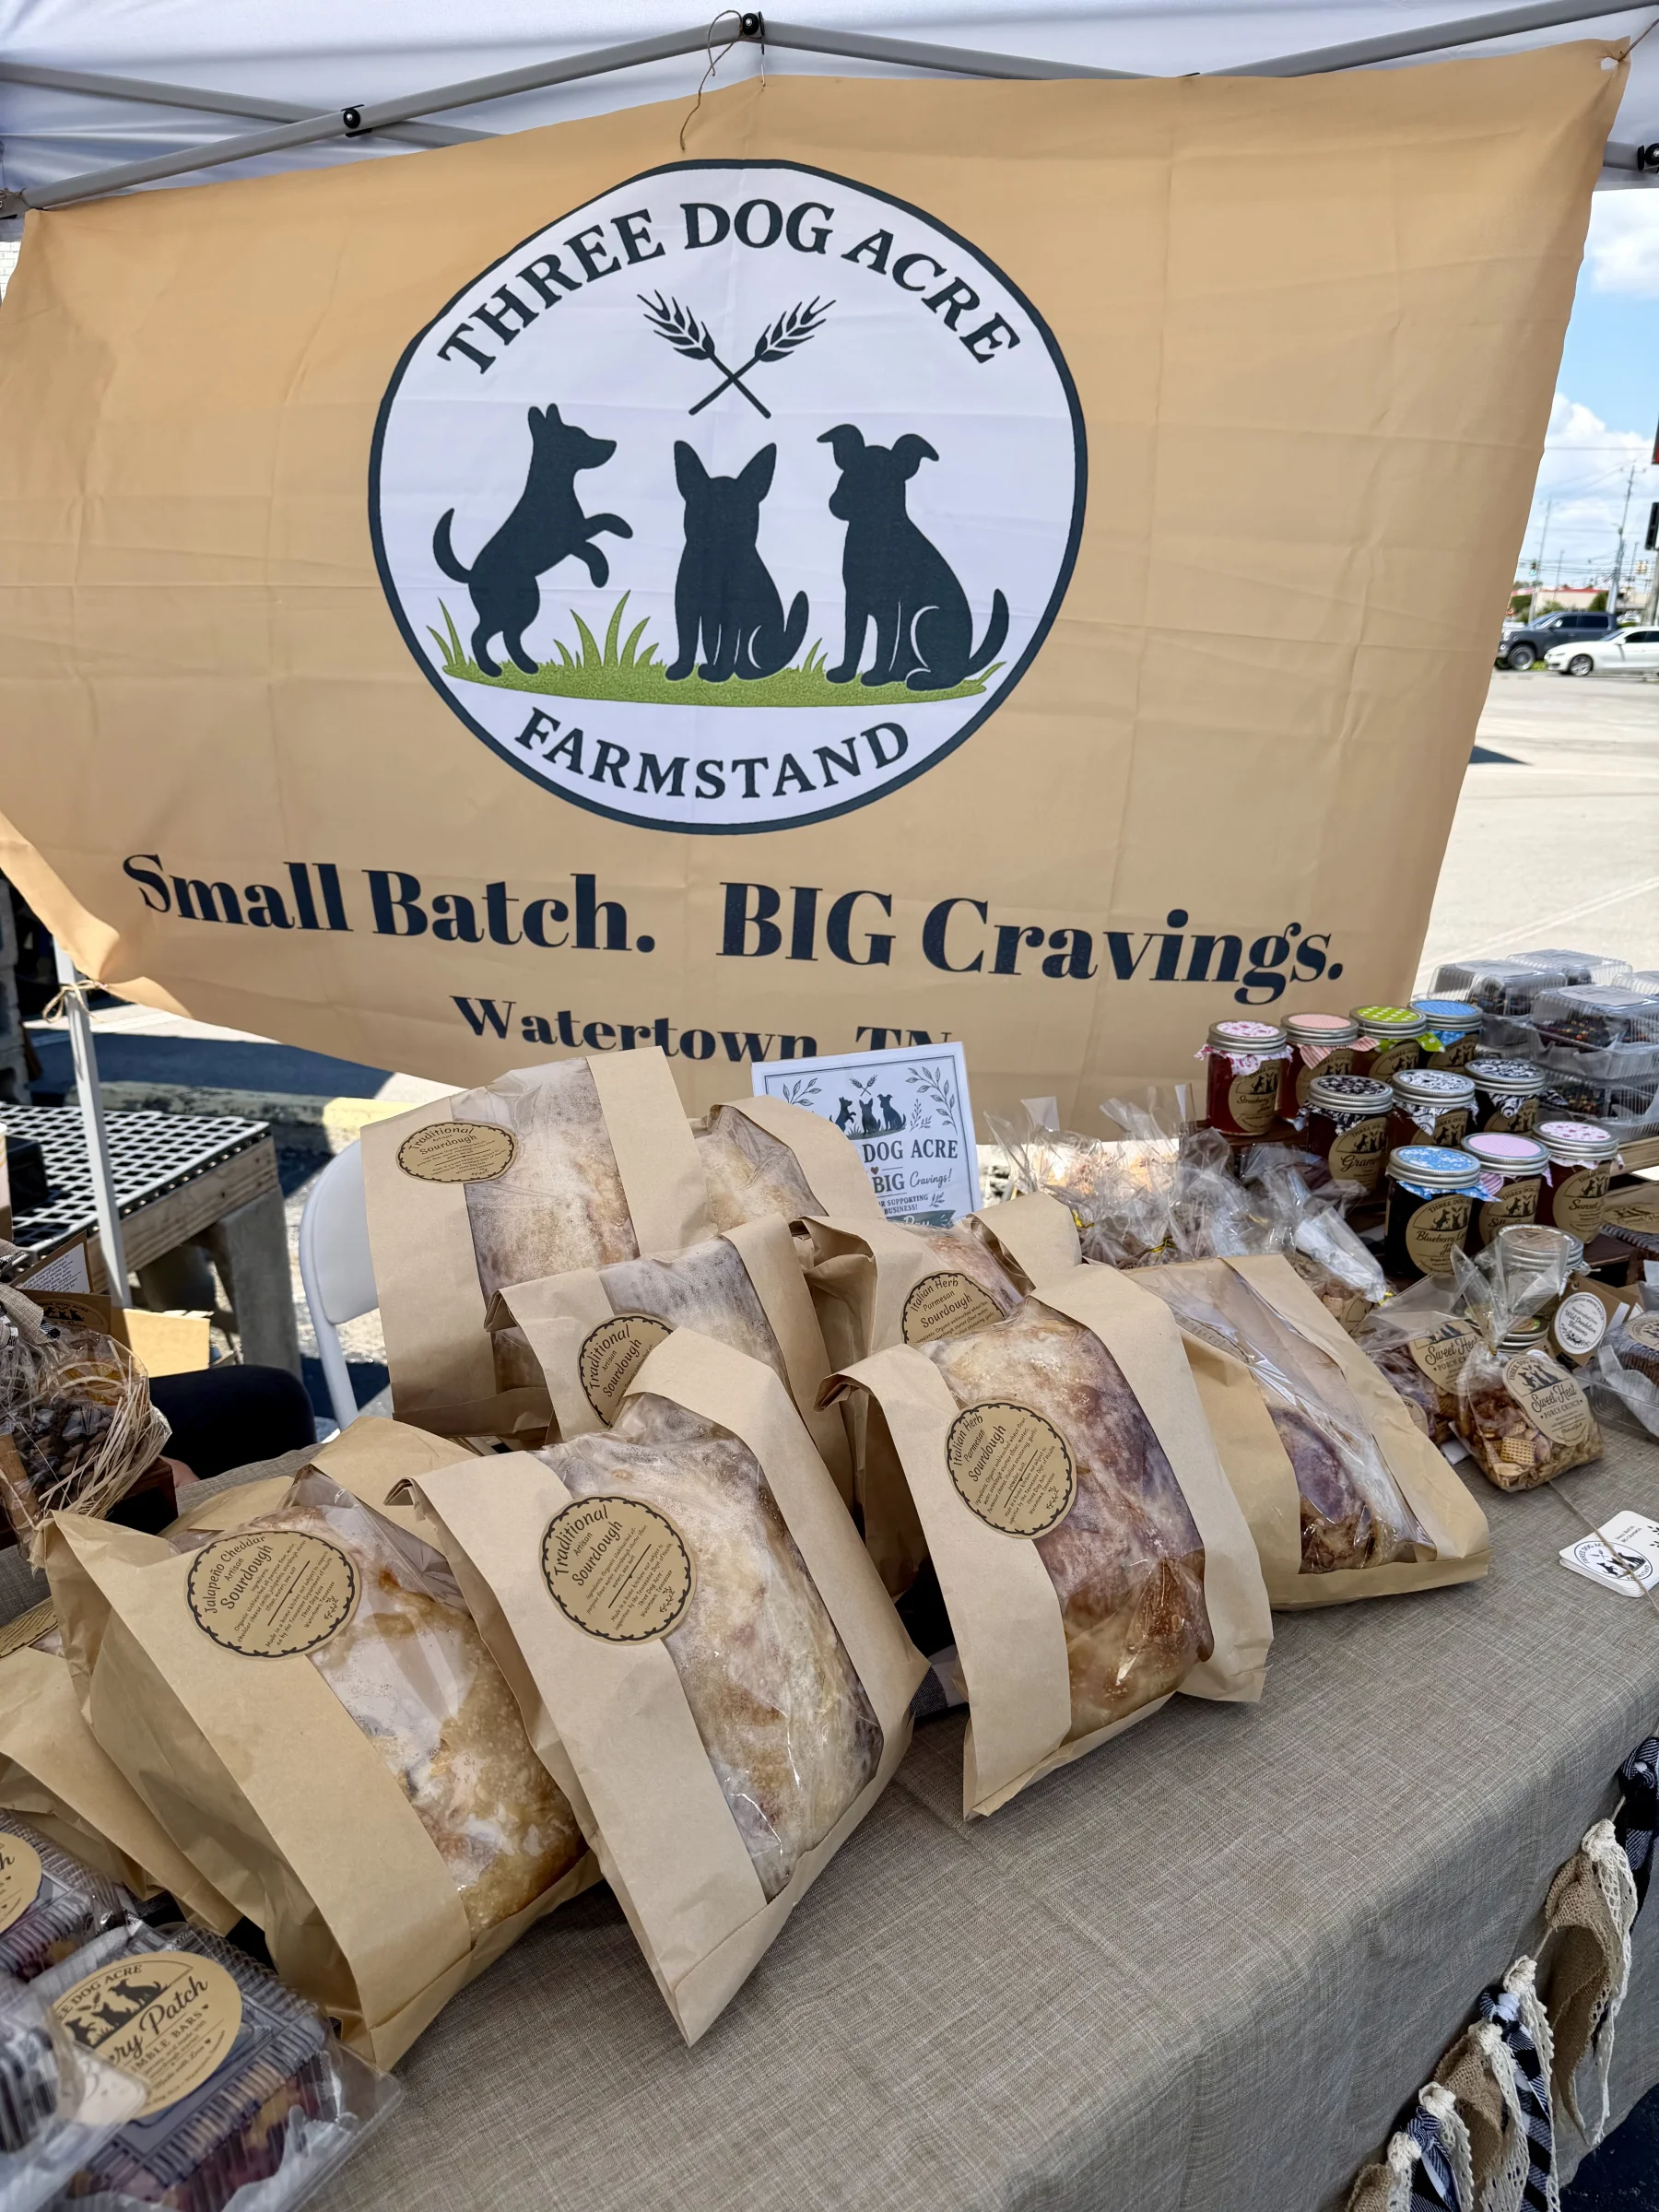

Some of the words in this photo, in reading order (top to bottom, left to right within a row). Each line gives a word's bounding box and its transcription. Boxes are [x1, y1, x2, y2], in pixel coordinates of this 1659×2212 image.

[436, 209, 668, 375] THREE
[679, 197, 836, 255] DOG
[841, 229, 1023, 364] ACRE
[514, 705, 911, 800] FARMSTAND
[123, 853, 355, 932] Small
[361, 868, 655, 953] Batch.
[715, 880, 897, 968] BIG
[922, 897, 1344, 1006] Cravings.
[449, 995, 818, 1063] Watertown
[408, 1127, 475, 1150] Traditional
[420, 1135, 477, 1155] Sourdough
[862, 1140, 904, 1163] DOG
[911, 1139, 959, 1159] ACRE
[874, 1172, 906, 1194] BIG
[909, 1168, 953, 1189] Cravings!
[884, 1203, 918, 1215] BUSINESS!
[887, 1194, 929, 1207] SUPPORTING
[1416, 1230, 1455, 1243] Blueberry
[1440, 1244, 1452, 1255] Ja
[910, 1284, 935, 1312] Italian
[935, 1277, 959, 1289] Herb
[920, 1292, 973, 1328] Sourdough
[923, 1290, 956, 1312] Parmesan
[588, 1323, 630, 1390] Traditional
[602, 1350, 617, 1372] Artisan
[602, 1338, 642, 1398] Sourdough
[1425, 1346, 1457, 1366] Sweet
[1531, 1393, 1557, 1413] Sweet
[1557, 1384, 1577, 1403] Heat
[953, 1430, 967, 1466] Italian
[963, 1413, 983, 1432] Herb
[964, 1429, 985, 1462] Parmesan
[968, 1424, 1006, 1483] Sourdough
[554, 1504, 609, 1576] Traditional
[572, 1520, 624, 1587] Sourdough
[573, 1532, 593, 1557] Artisan
[202, 1563, 225, 1614] Jalapeño
[221, 1536, 266, 1562] Cheddar
[221, 1545, 273, 1609] Sourdough
[224, 1558, 244, 1582] Artisan
[73, 1981, 102, 2005] DOG
[104, 1964, 143, 1984] ACRE
[139, 1976, 208, 2035] Patch
[171, 2011, 203, 2038] BARS
